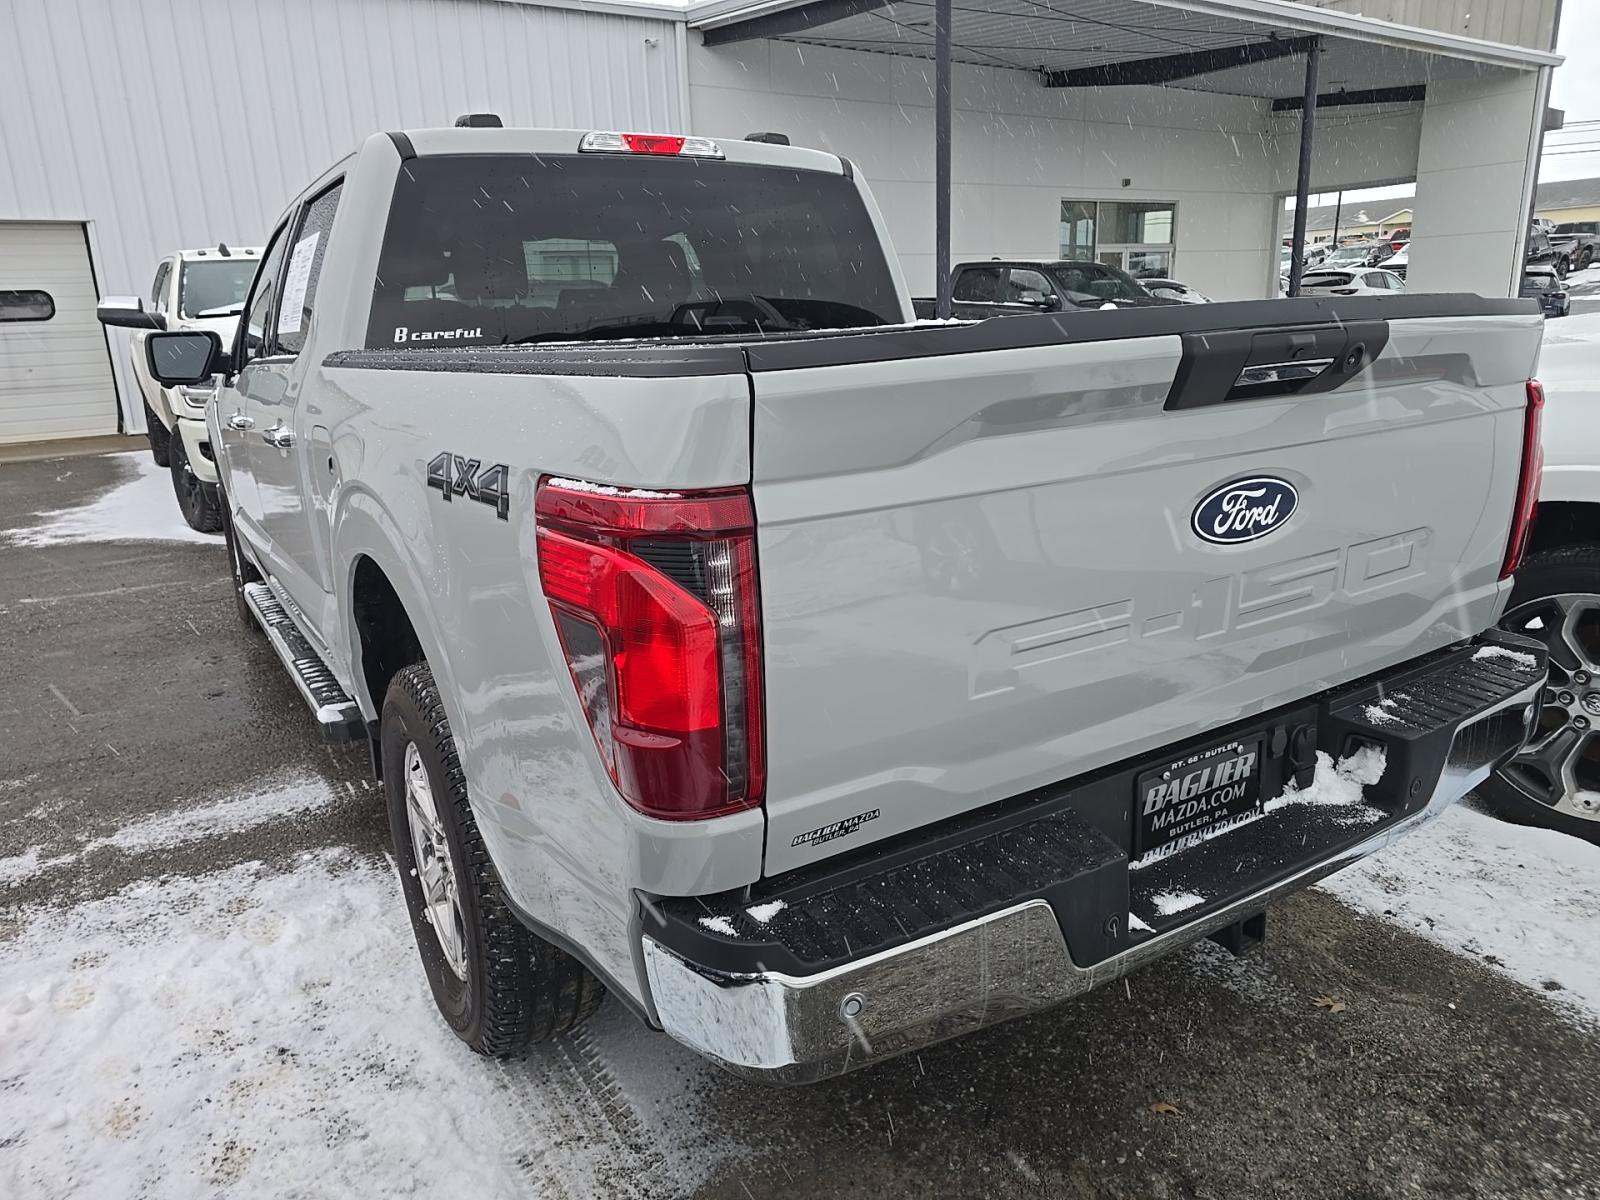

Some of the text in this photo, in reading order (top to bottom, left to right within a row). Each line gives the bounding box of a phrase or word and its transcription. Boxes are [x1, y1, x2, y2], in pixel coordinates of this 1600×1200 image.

[393, 327, 483, 343] B careful
[1213, 487, 1282, 535] Ford
[967, 525, 1434, 701] F-150
[1171, 759, 1186, 770] RT.
[1205, 742, 1239, 758] BUTLER
[1143, 752, 1256, 815] BAGLIER
[1151, 781, 1247, 832] MAZDA.COM
[842, 808, 880, 830] MAZDA
[1142, 807, 1262, 862] BAGLIERMAZDACOM
[1169, 807, 1229, 837] BUTLER, PA
